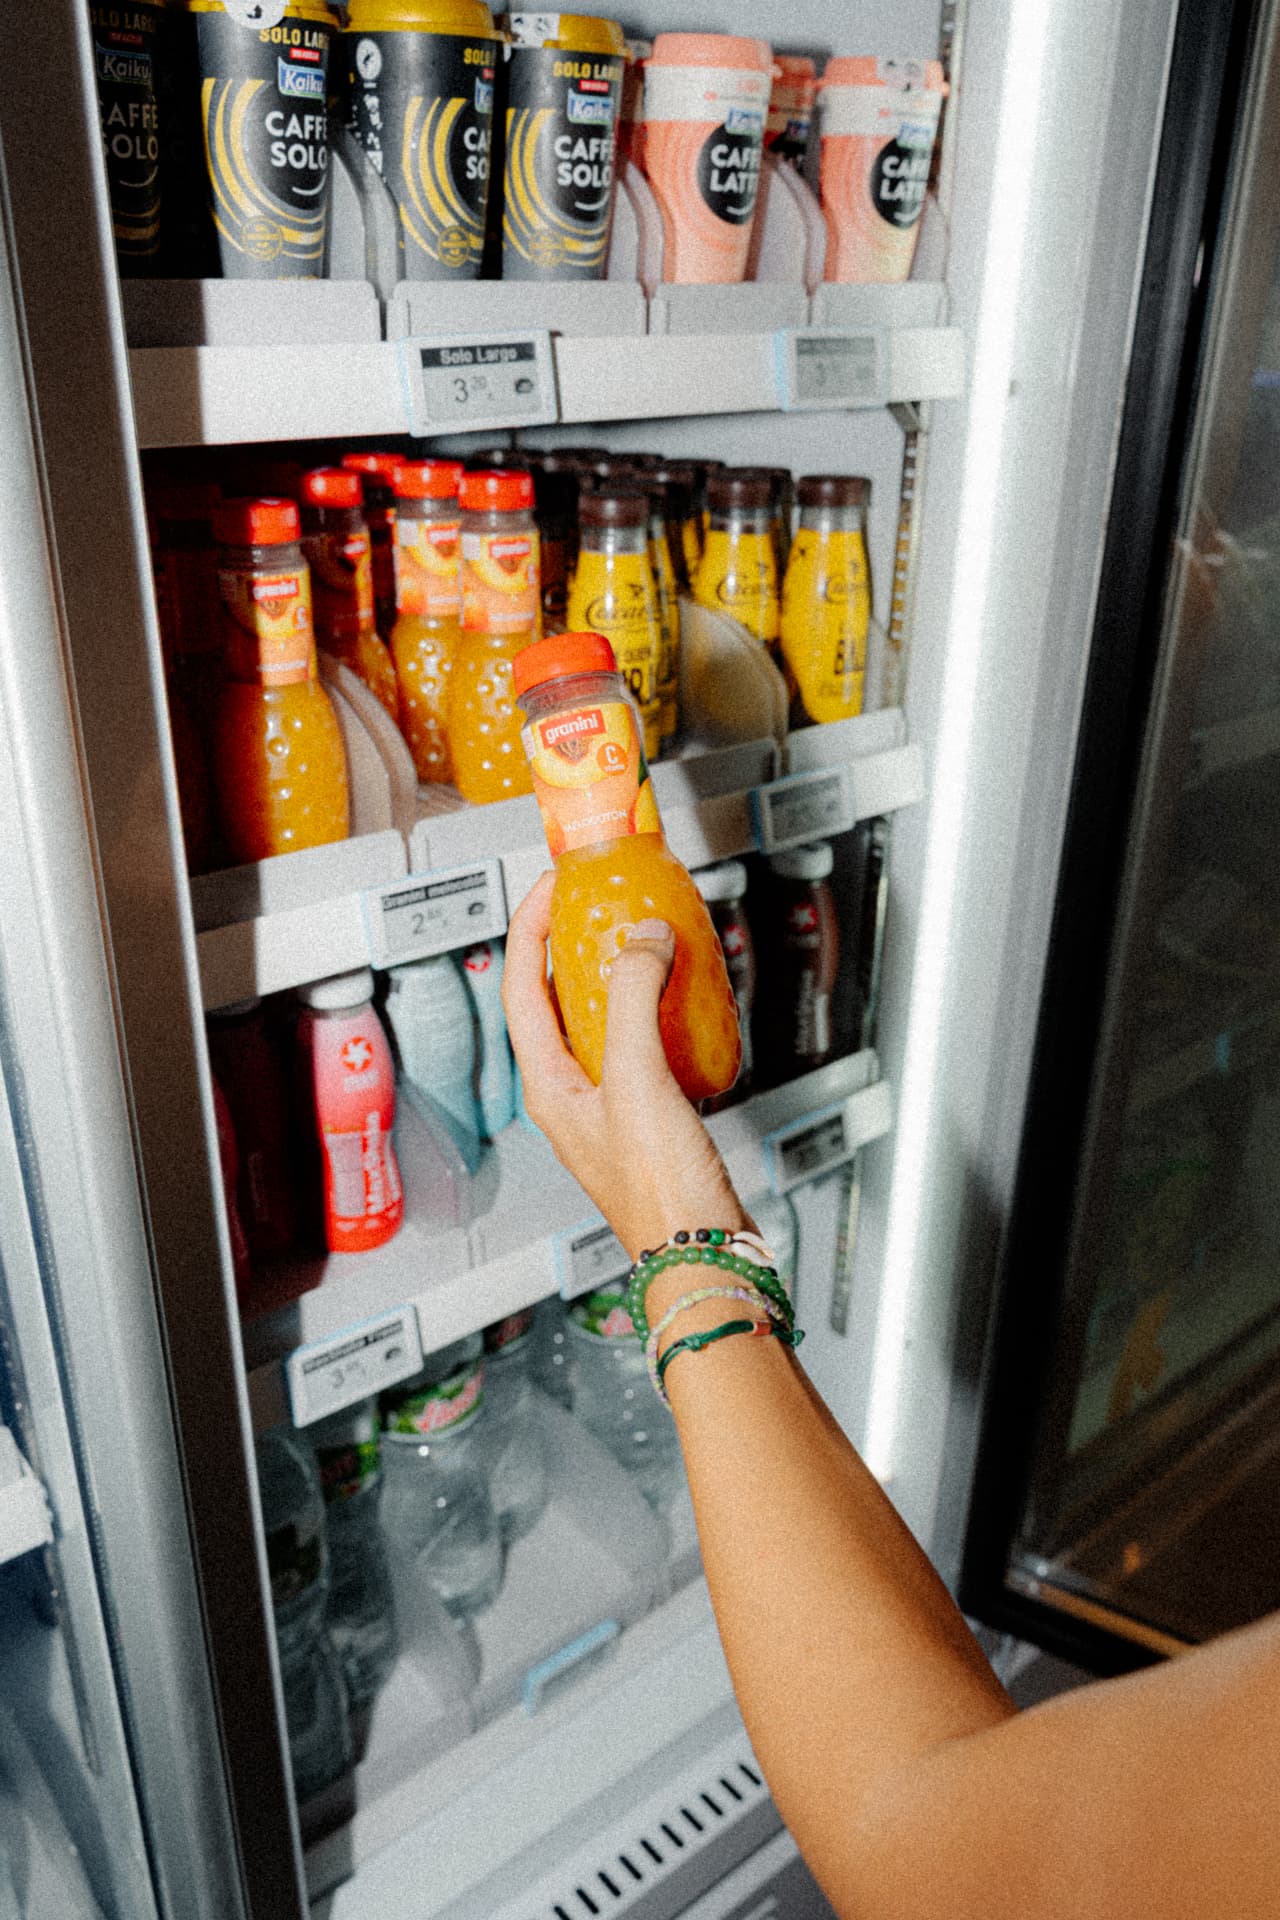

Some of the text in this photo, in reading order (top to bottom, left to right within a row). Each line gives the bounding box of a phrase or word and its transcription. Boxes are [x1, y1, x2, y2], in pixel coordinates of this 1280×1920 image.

[259, 26, 329, 50] SOLO LAR
[102, 54, 150, 82] Kaiku
[553, 61, 591, 78] SOLO
[463, 127, 489, 152] CA
[554, 135, 612, 161] CAFF
[270, 141, 327, 171] SOLO
[466, 155, 488, 180] SO
[709, 169, 757, 194] LATT
[440, 346, 518, 365] Solo Largo
[453, 378, 469, 403] 3
[545, 713, 599, 744] granini
[604, 744, 619, 765] C
